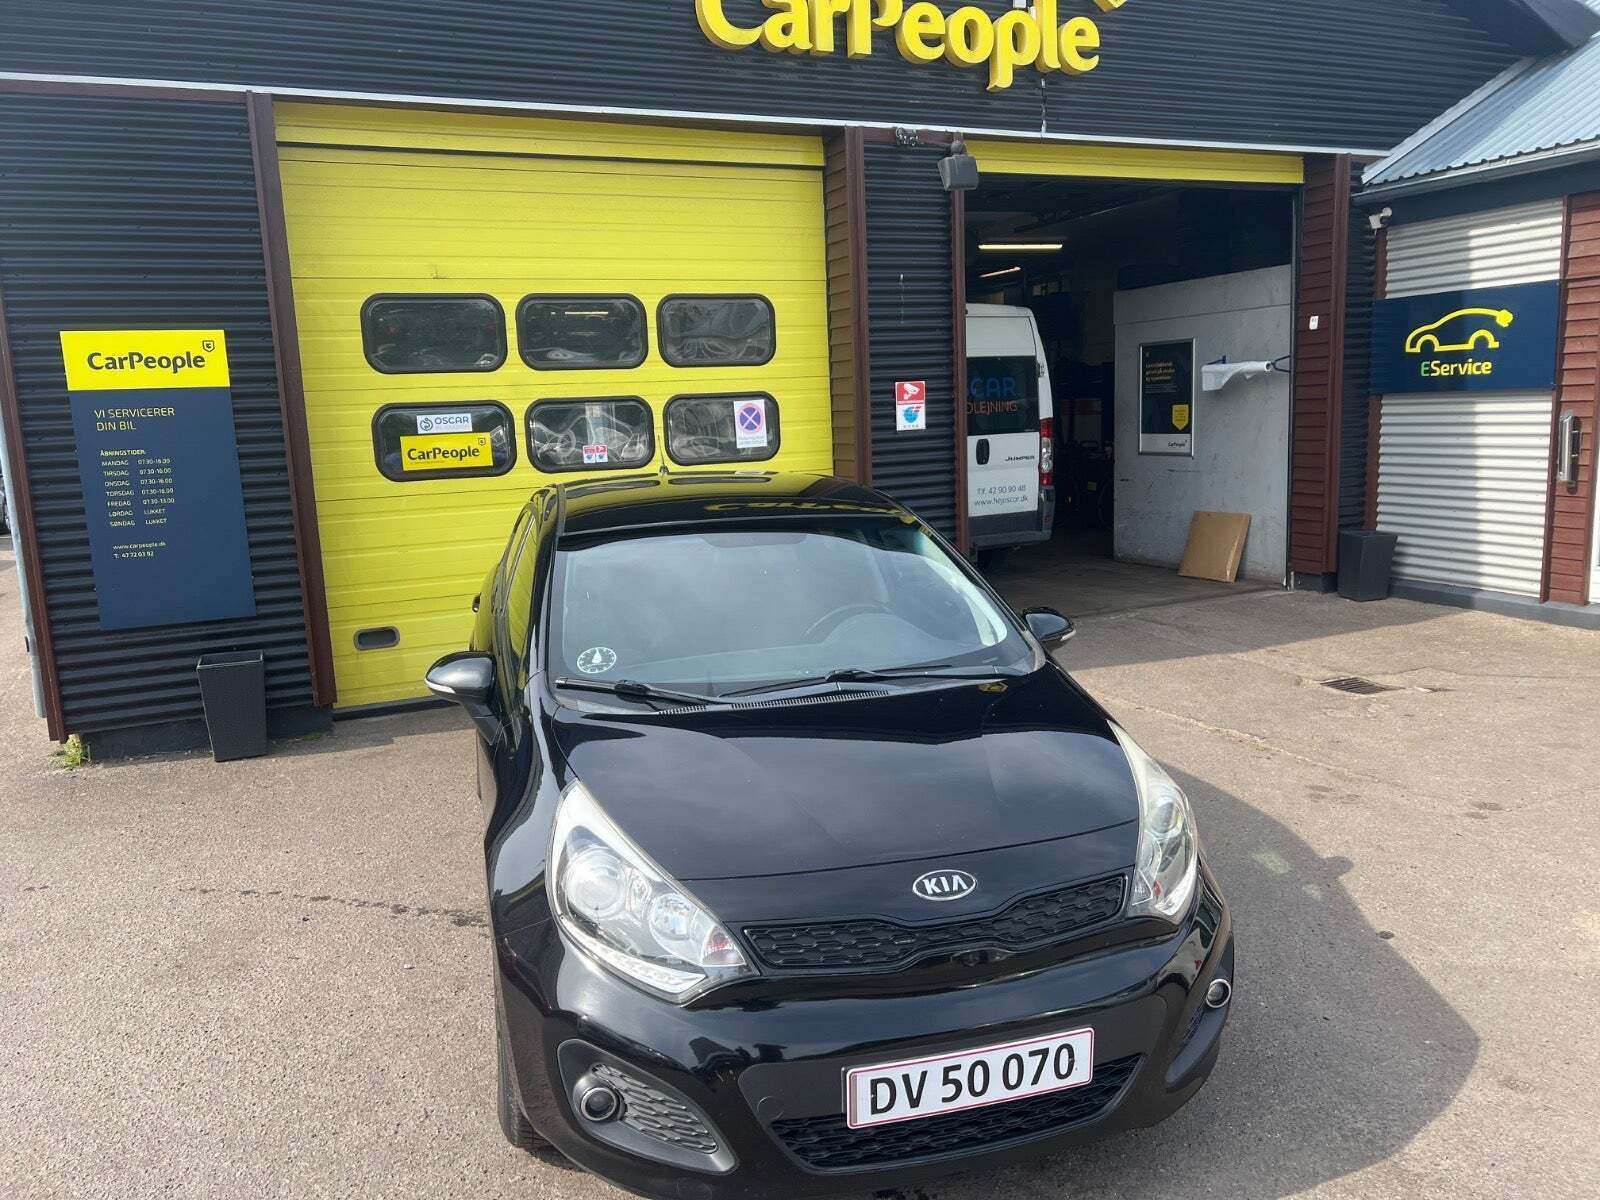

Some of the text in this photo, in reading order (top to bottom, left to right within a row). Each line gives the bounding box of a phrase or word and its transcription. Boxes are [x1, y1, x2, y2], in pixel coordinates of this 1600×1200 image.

[697, 0, 1100, 91] CarPeople
[87, 351, 206, 374] CarPeople
[1420, 358, 1492, 377] EService
[967, 376, 1016, 398] CAR
[94, 407, 175, 419] VI SERVICERER
[434, 416, 470, 425] OSCAR
[96, 421, 136, 431] DIN BIL
[407, 446, 480, 461] CarPeople
[112, 541, 167, 550] www.carpeople.dk
[923, 874, 969, 895] KIA
[870, 1043, 1076, 1116] DV 50 070
